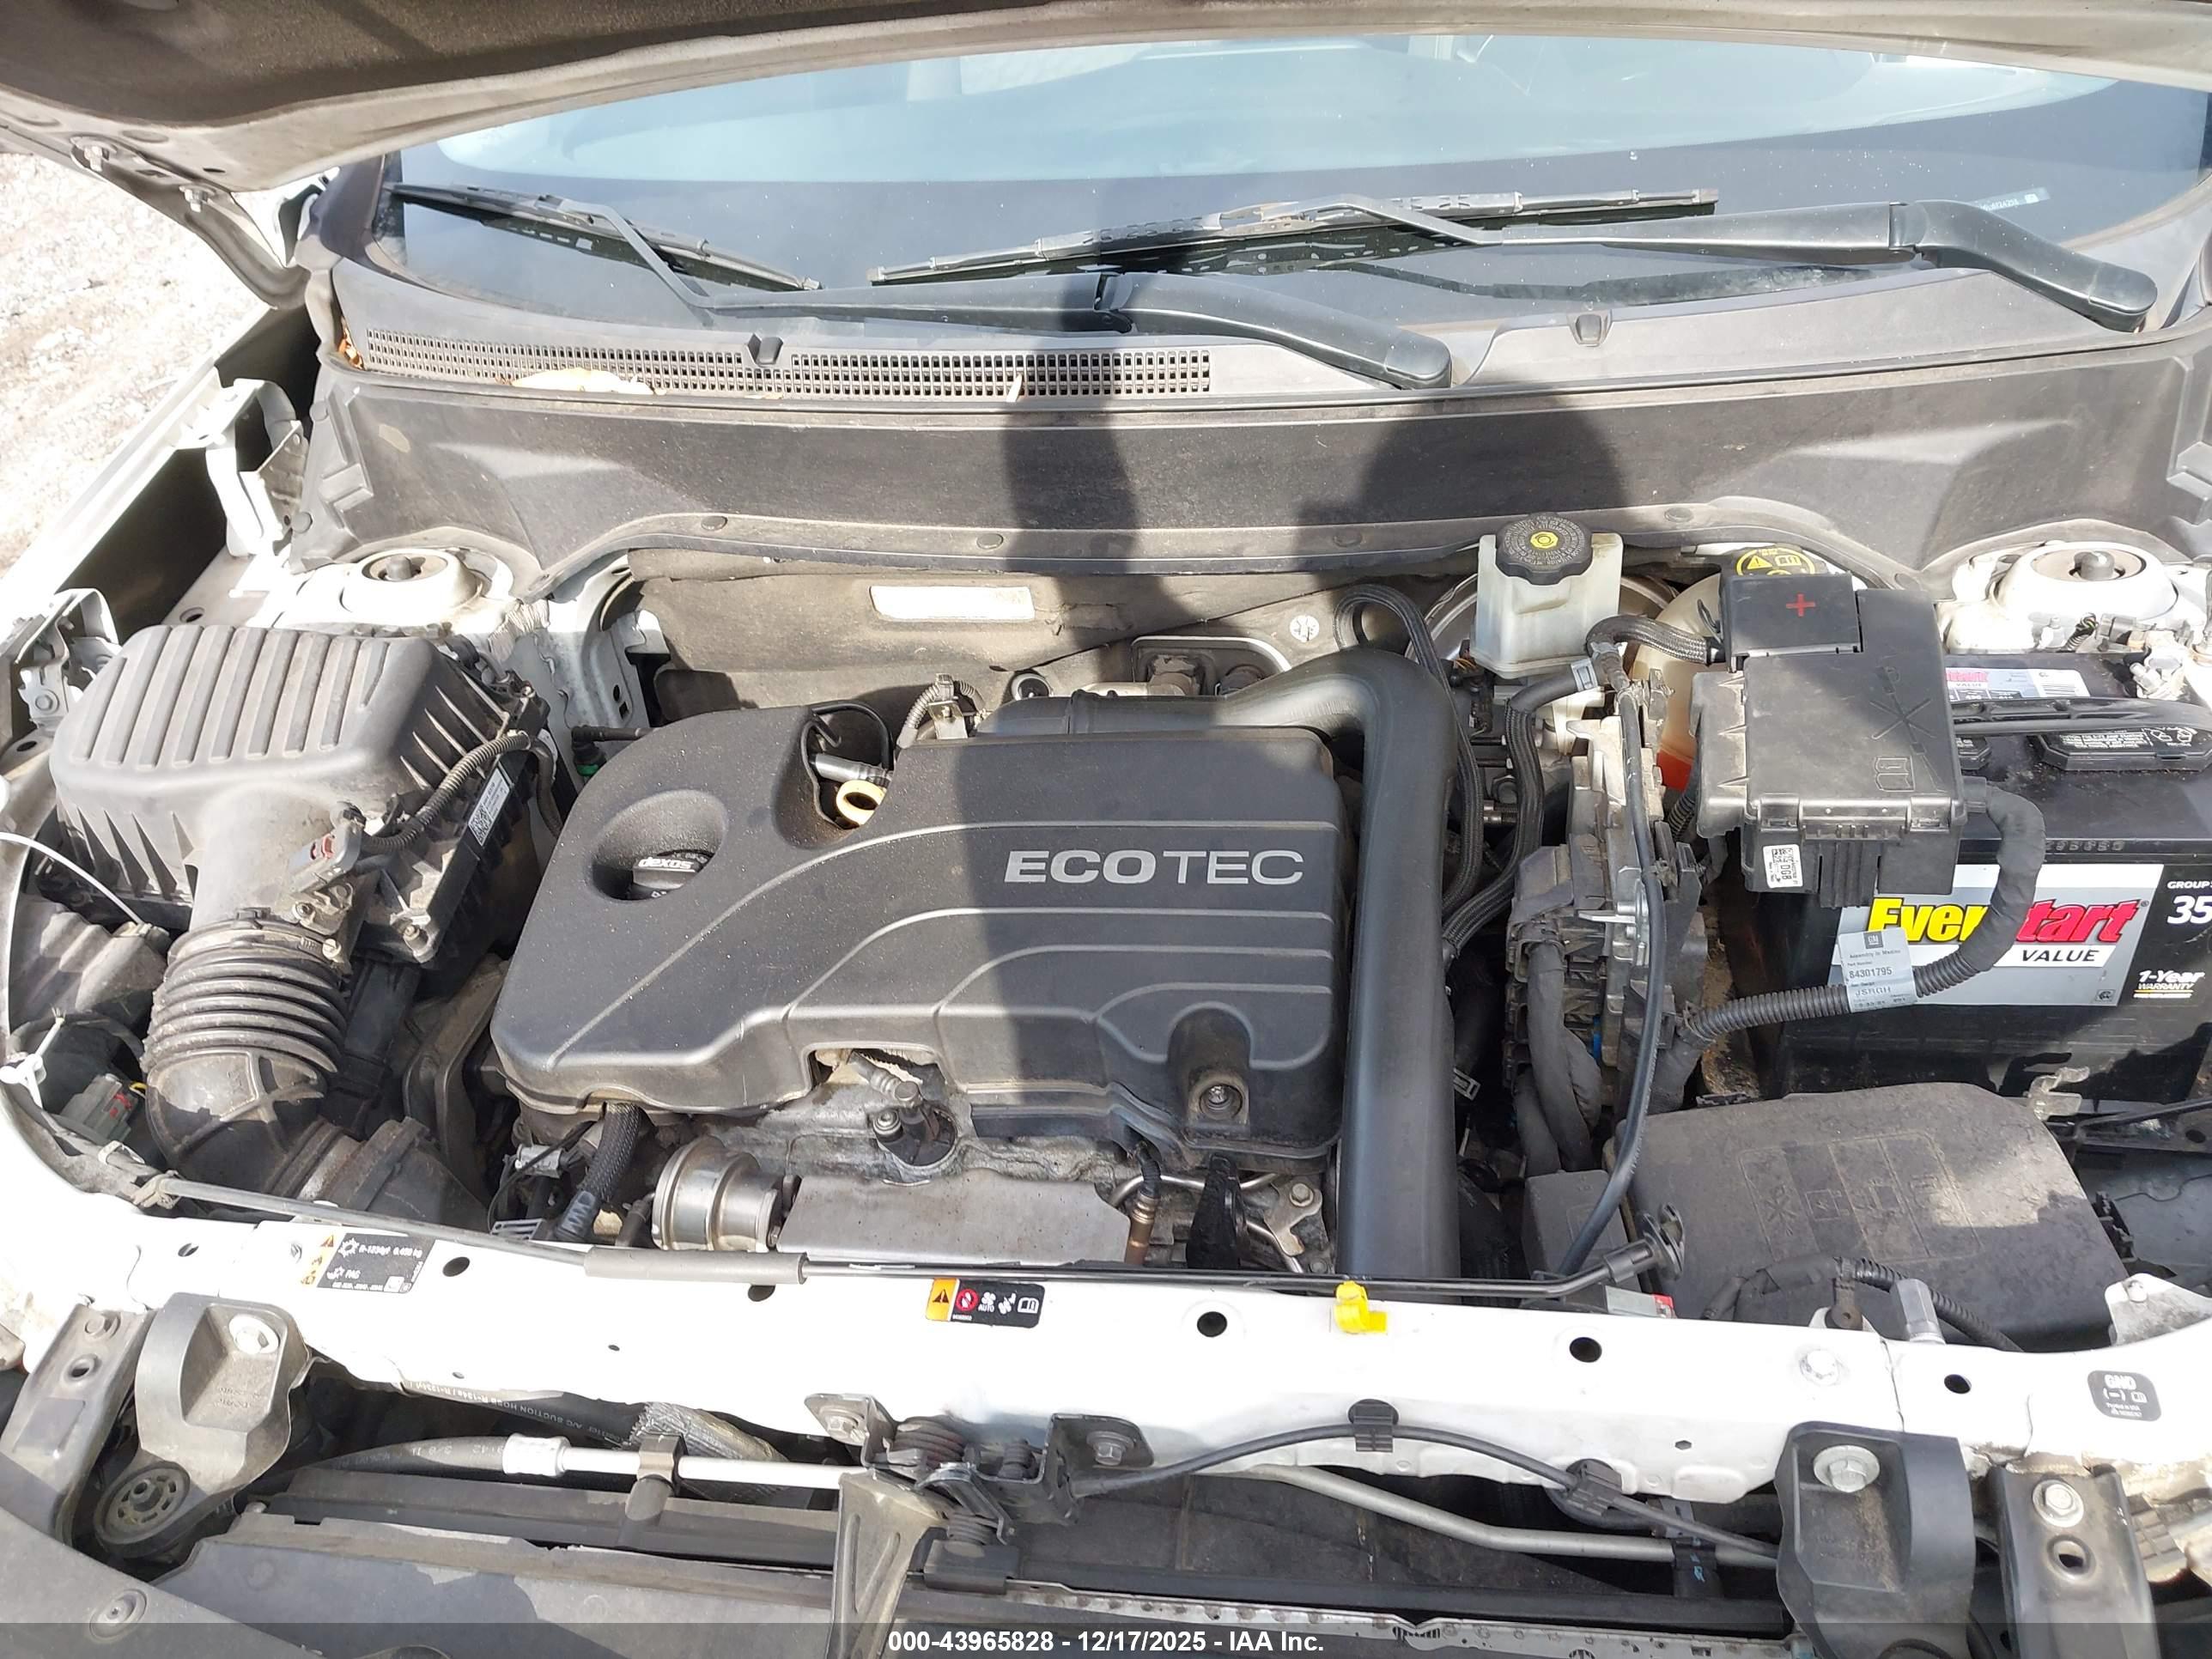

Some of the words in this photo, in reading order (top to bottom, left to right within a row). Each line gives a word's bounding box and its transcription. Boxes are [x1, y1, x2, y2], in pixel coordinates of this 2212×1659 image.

[638, 857, 694, 870] dexos
[1005, 849, 1304, 886] ECOTEC
[2166, 880, 2210, 890] GROUP
[2166, 895, 2212, 925] 35
[2021, 949, 2100, 963] VALUE
[1849, 966, 1893, 979] 84301795
[2139, 969, 2205, 983] 1-Year
[978, 1304, 995, 1313] AUTO
[520, 1405, 563, 1424] SUCTION
